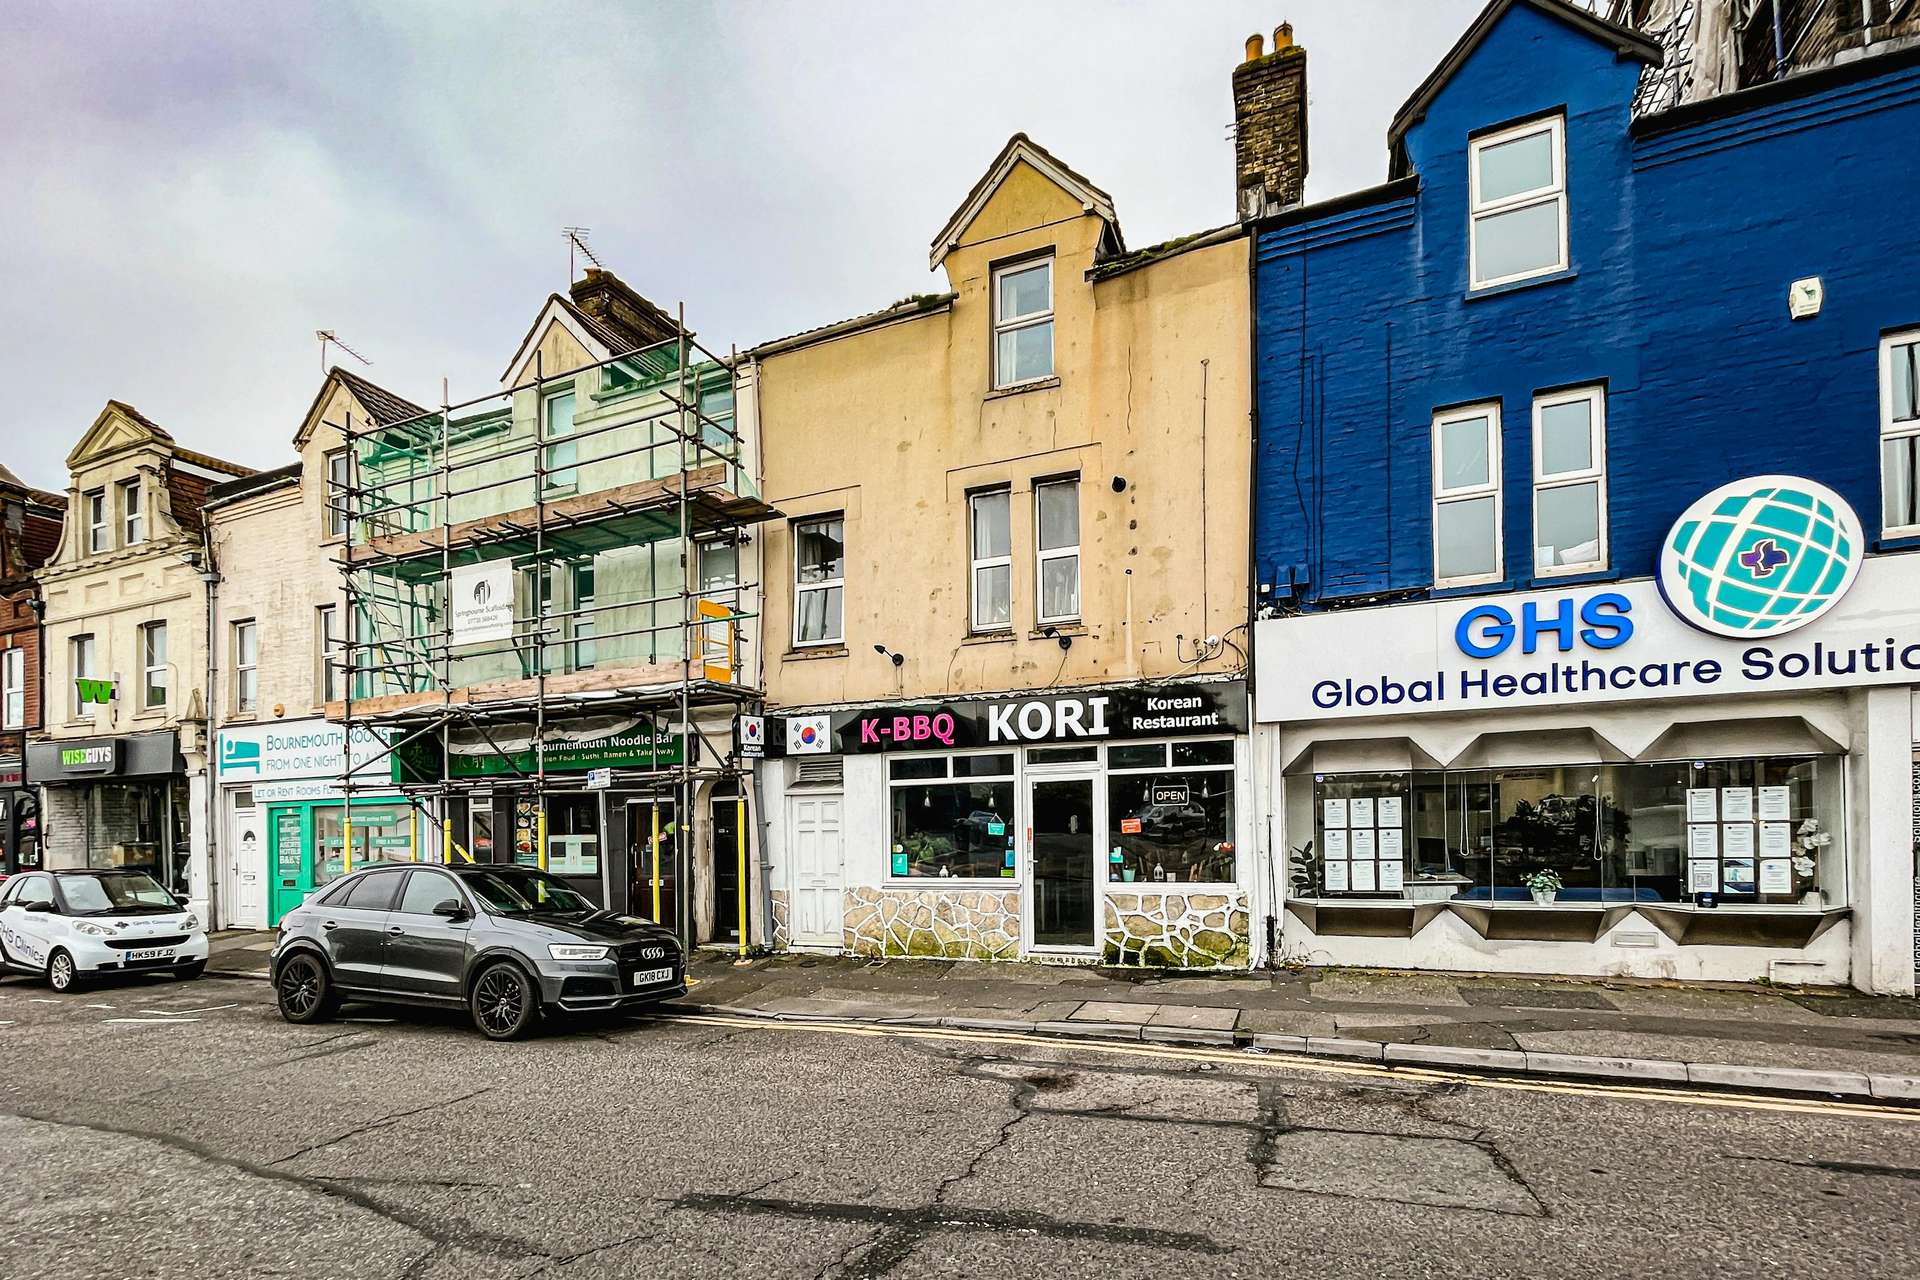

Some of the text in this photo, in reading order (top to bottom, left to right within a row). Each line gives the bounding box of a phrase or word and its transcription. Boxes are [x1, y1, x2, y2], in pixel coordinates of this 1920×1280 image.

[1455, 593, 1634, 659] GHS
[75, 679, 113, 704] W
[1312, 671, 1444, 708] Global
[1461, 660, 1722, 699] Healthcare
[1147, 697, 1202, 711] Korean
[861, 697, 1110, 745] K-BBQ KORI
[1132, 712, 1219, 730] Restaurant
[266, 732, 343, 751] BOURNEMOUTH
[611, 733, 651, 747] Noodle
[656, 733, 673, 744] Bar
[62, 746, 112, 766] WISEGUYS
[266, 758, 290, 770] FROM
[296, 785, 320, 795] ROOMS
[1156, 791, 1186, 801] OPEN
[0, 920, 14, 943] HS
[132, 951, 155, 959] HK59
[657, 969, 669, 980] CXJ
